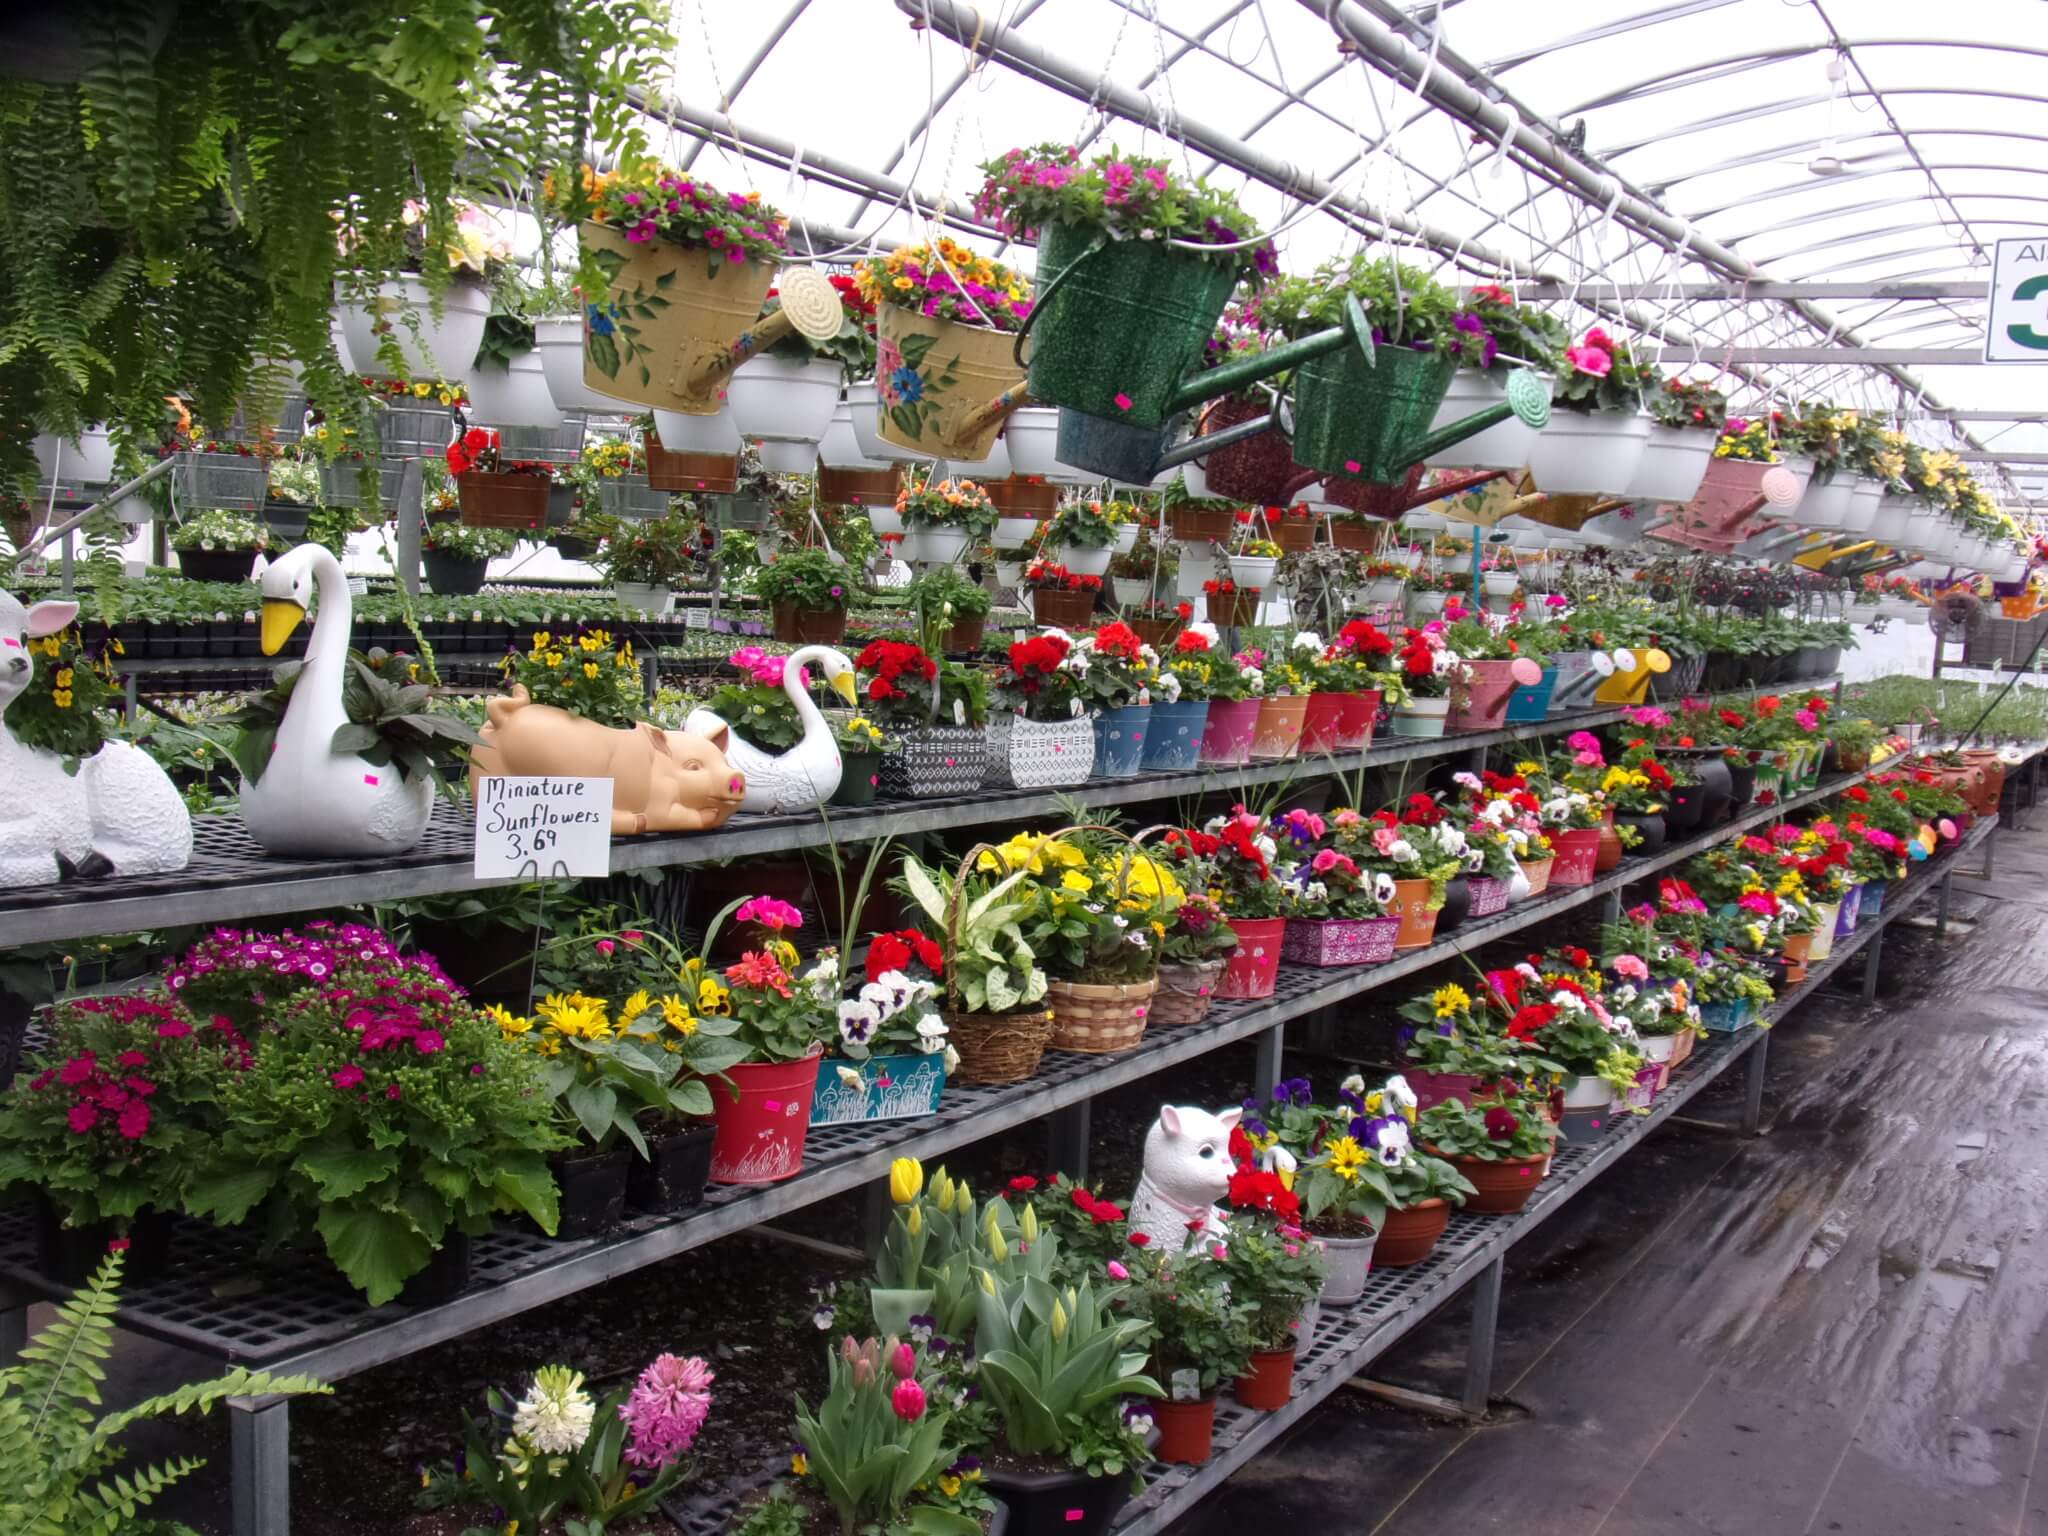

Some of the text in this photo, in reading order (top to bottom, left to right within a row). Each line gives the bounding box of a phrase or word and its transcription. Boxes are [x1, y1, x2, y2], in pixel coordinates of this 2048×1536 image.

[2014, 244, 2048, 262] AI
[824, 263, 857, 276] AIS
[486, 777, 585, 804] Miniature
[485, 801, 600, 834] Sunflowers
[505, 828, 557, 860] 3.69
